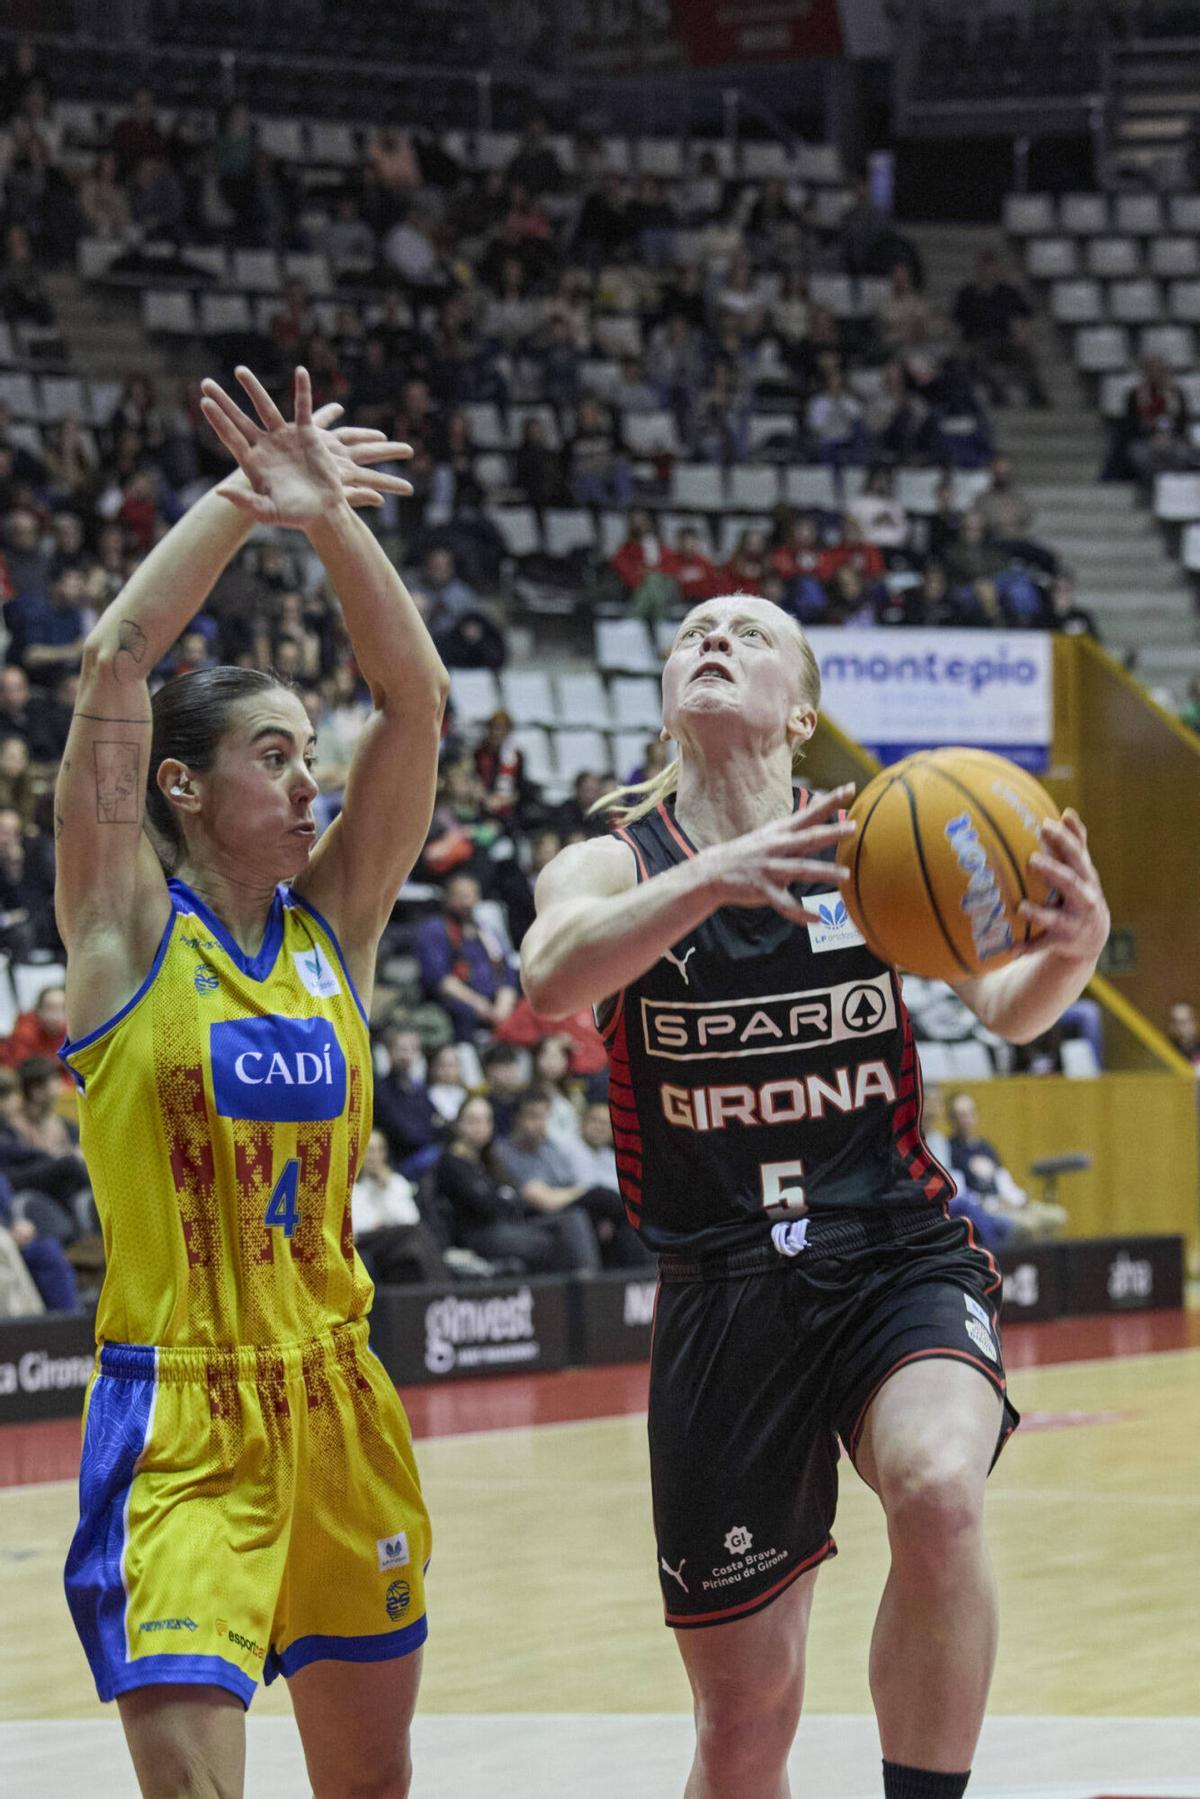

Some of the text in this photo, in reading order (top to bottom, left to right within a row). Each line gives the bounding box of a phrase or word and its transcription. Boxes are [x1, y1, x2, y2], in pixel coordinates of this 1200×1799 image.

[821, 642, 1037, 694] montepio
[654, 1003, 828, 1047] SPAR
[235, 1043, 332, 1085] CADÍ
[660, 1058, 898, 1131] GIRONA
[263, 1157, 302, 1239] 4
[760, 1160, 808, 1219] 5
[702, 1550, 788, 1590] Pirineu de Girona
[711, 1548, 776, 1577] Costa Brava
